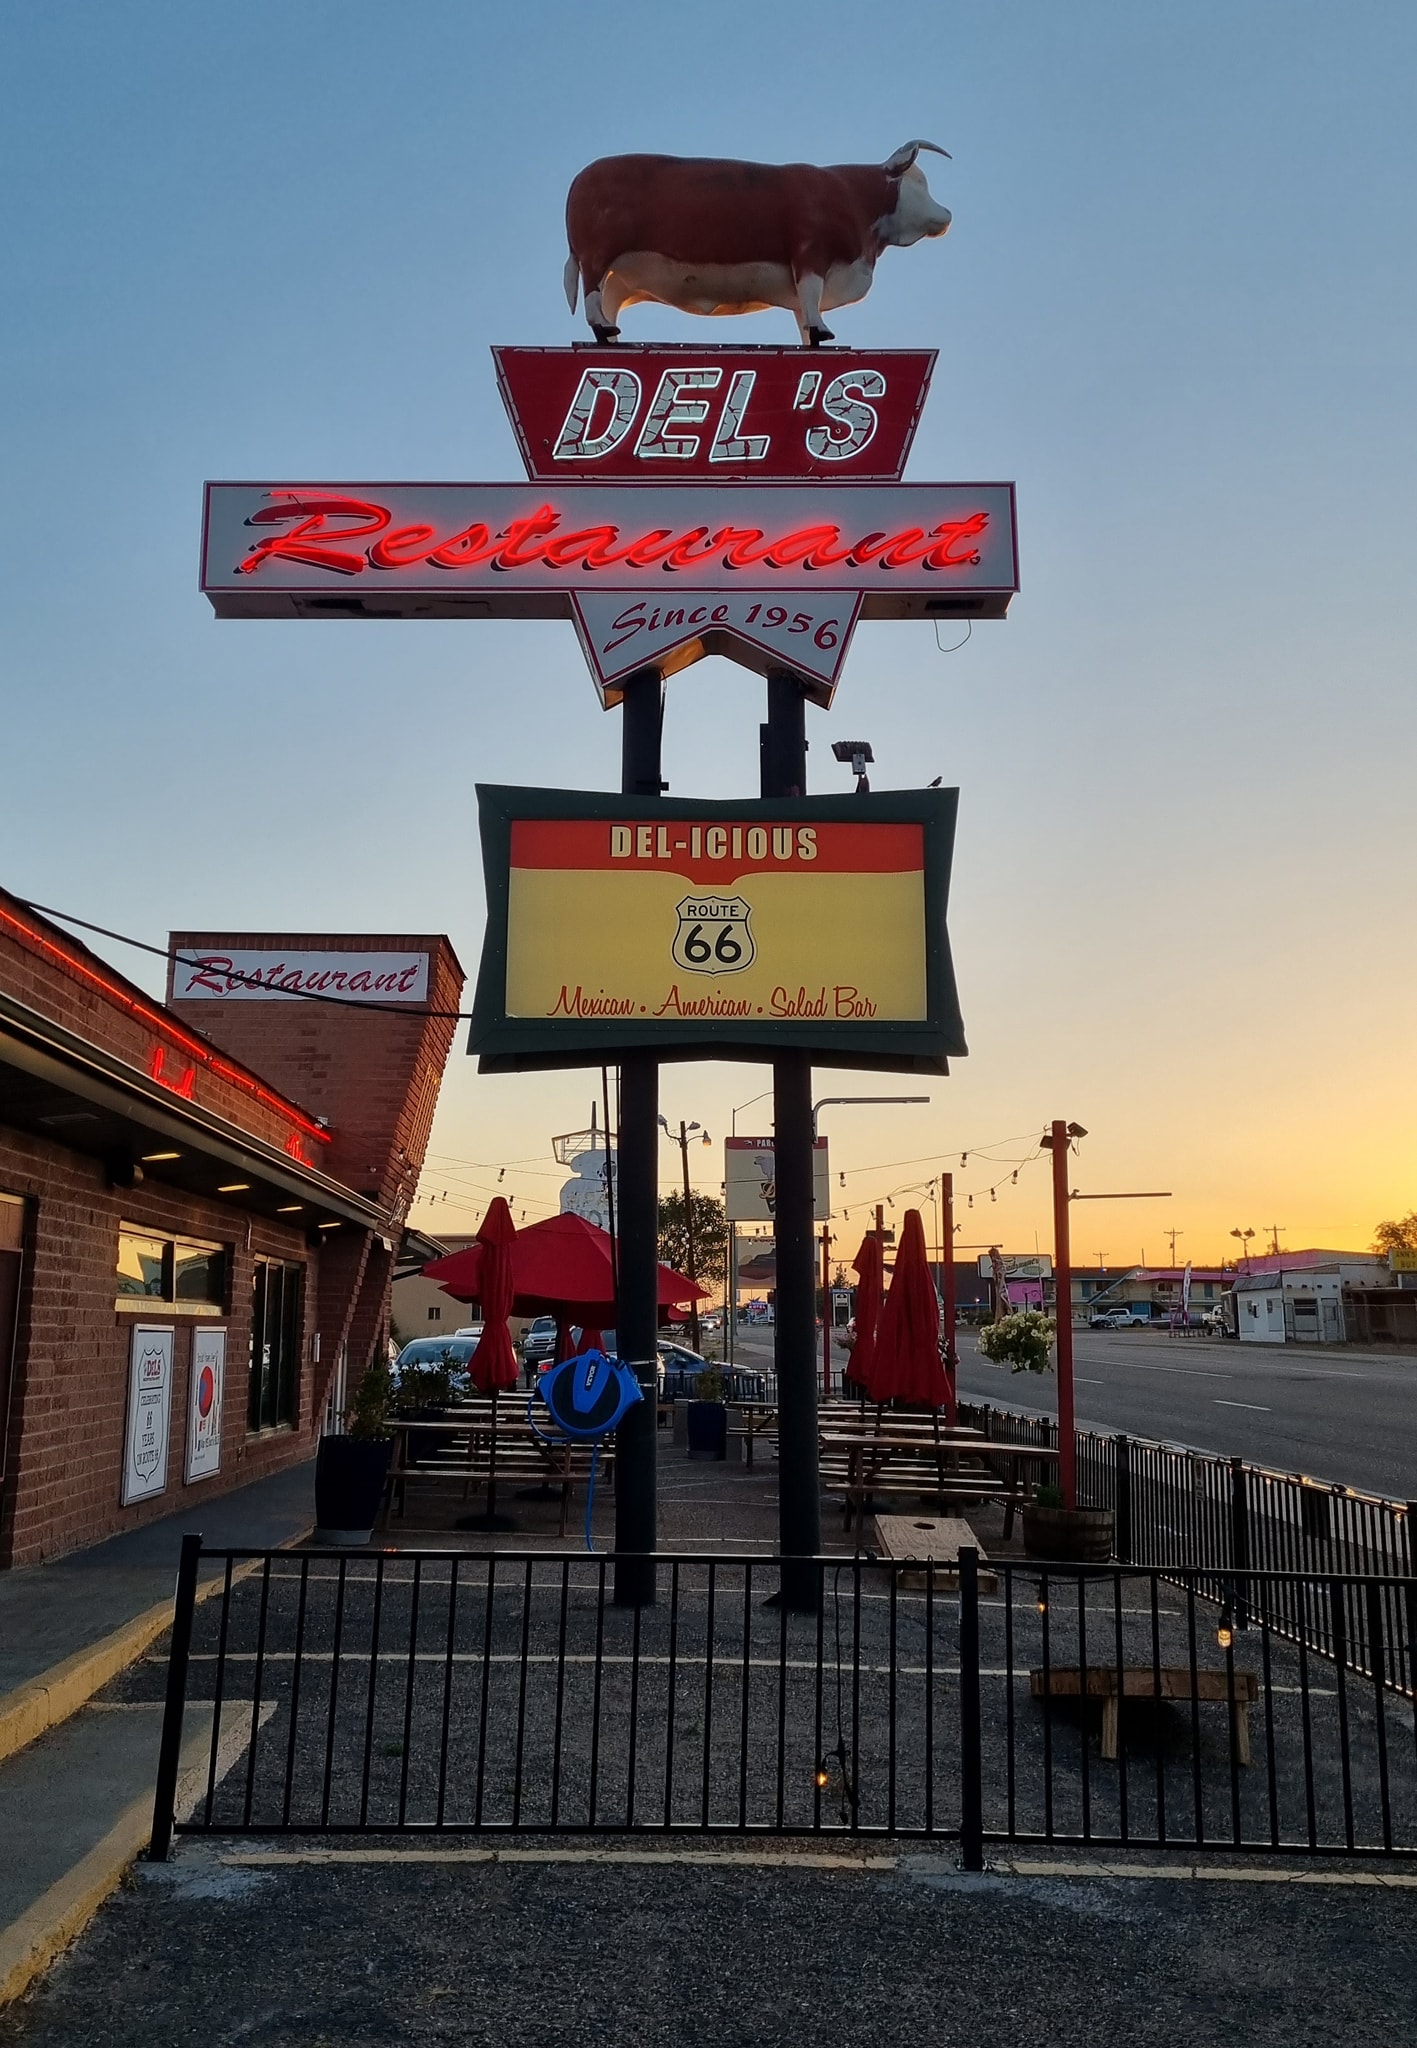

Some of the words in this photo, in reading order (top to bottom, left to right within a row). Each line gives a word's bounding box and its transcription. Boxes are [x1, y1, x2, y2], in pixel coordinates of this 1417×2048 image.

[551, 365, 888, 462] DEL'S
[232, 490, 990, 575] Restaurant
[602, 602, 730, 654] Since
[744, 603, 839, 650] 1956
[609, 825, 820, 861] DEL-ICIOUS
[687, 904, 740, 918] ROUTE
[684, 924, 743, 964] 66
[185, 956, 419, 993] Restaurant
[546, 985, 635, 1018] Mexican
[652, 985, 752, 1017] American
[769, 986, 828, 1017] Salad
[833, 986, 877, 1018] Bar
